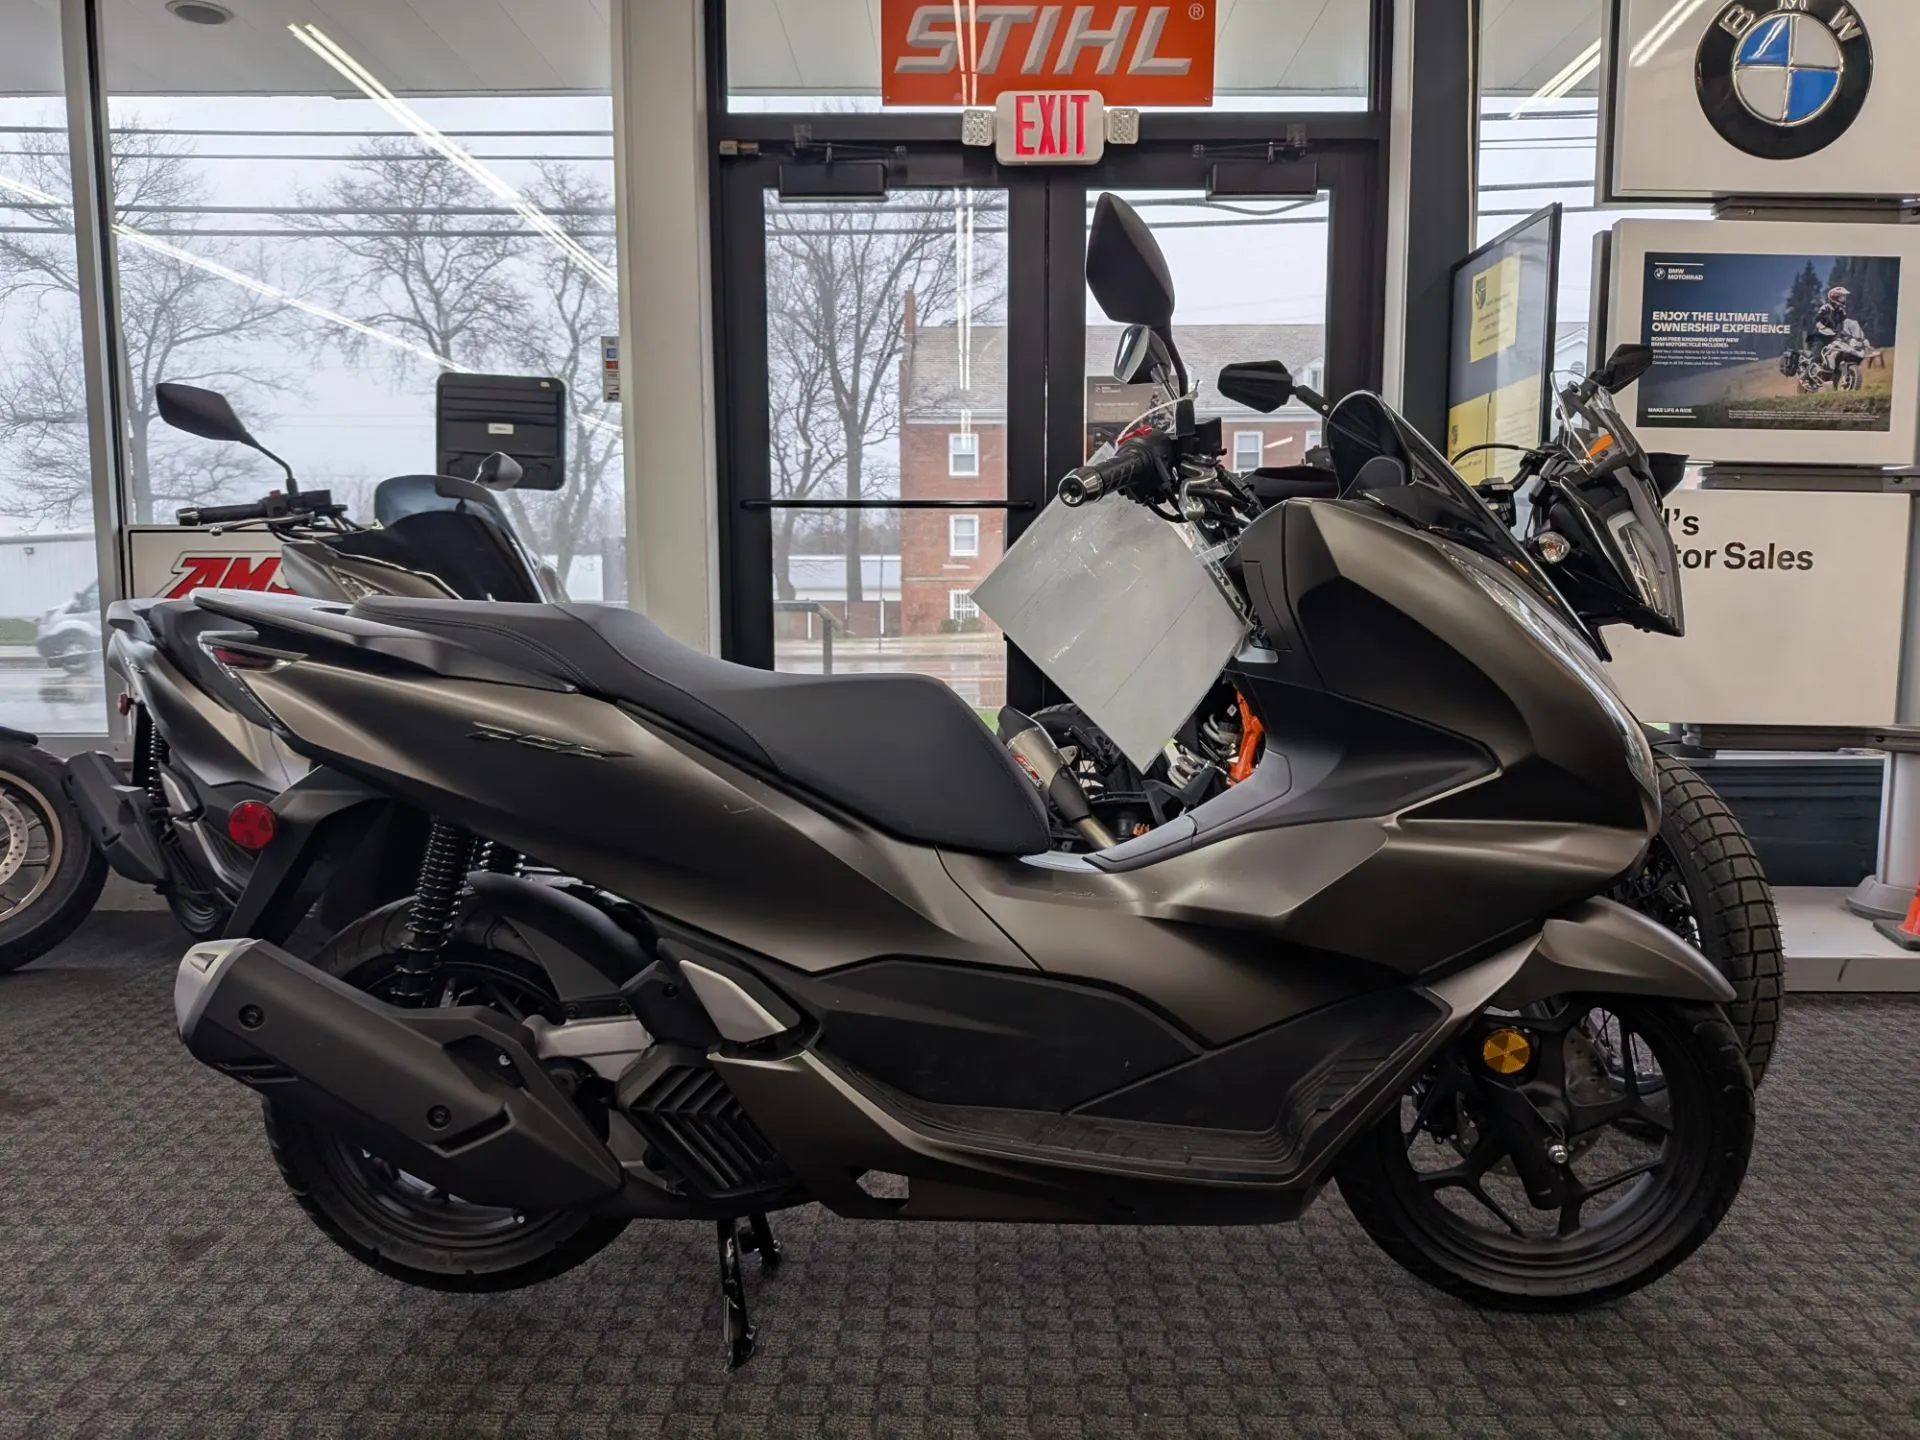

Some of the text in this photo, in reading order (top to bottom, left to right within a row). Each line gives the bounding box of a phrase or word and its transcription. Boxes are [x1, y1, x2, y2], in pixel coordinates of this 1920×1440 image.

[893, 5, 1192, 75] STIHL
[1015, 94, 1091, 157] EXIT
[1651, 322, 1791, 334] OWNERSHIP EXPERIENCE
[1652, 311, 1769, 322] ENJOY THE ULTIMATE
[1723, 542, 1813, 571] Sales
